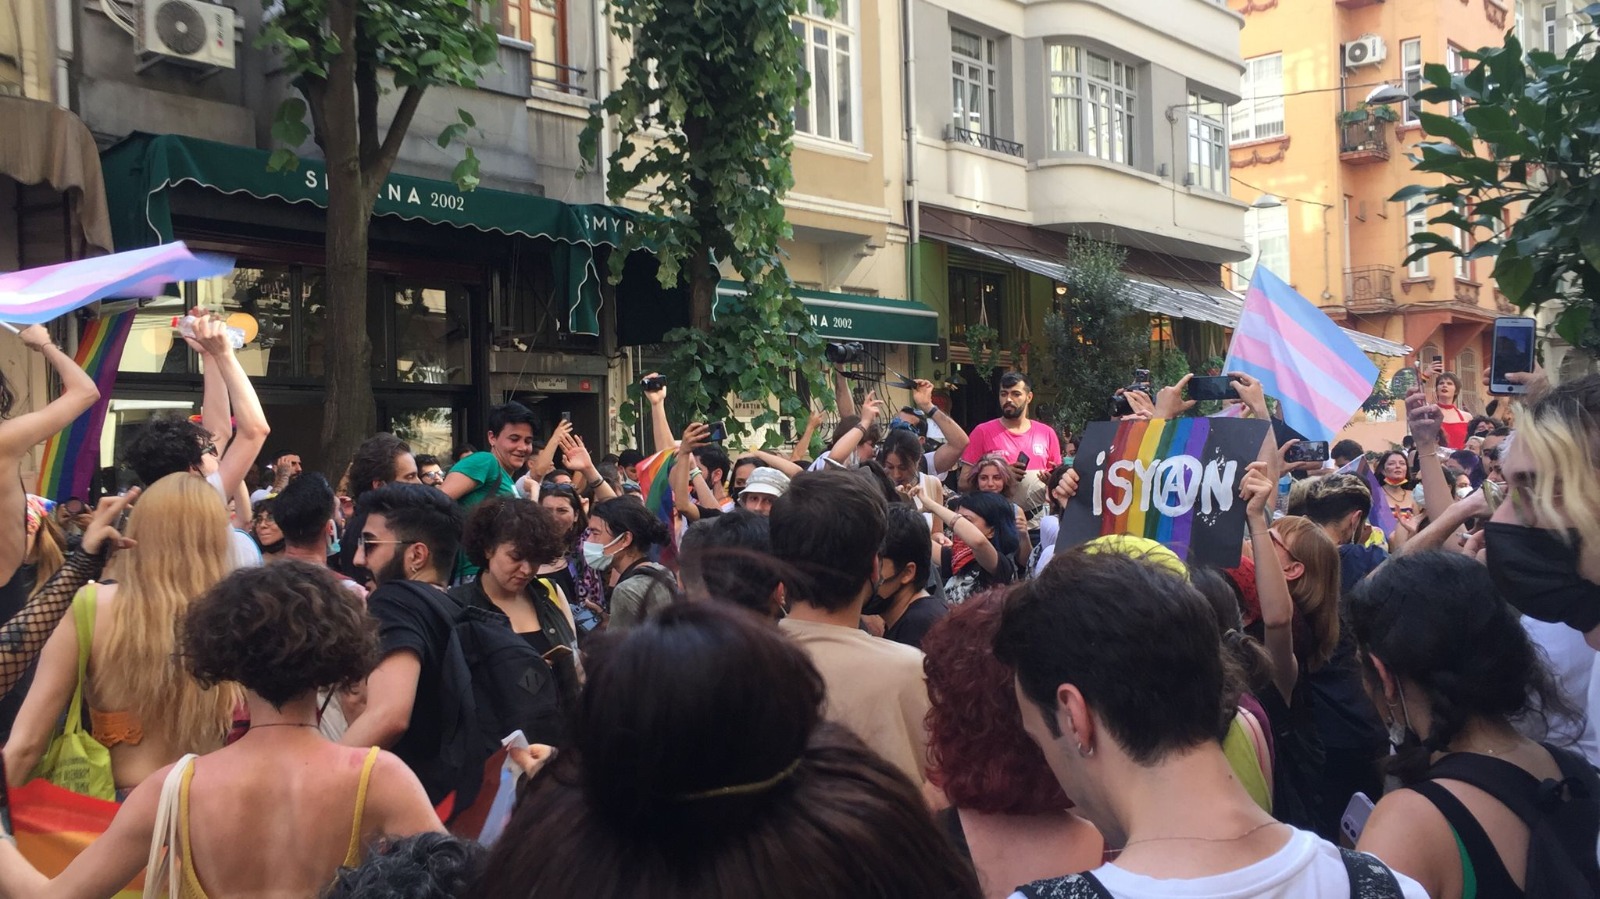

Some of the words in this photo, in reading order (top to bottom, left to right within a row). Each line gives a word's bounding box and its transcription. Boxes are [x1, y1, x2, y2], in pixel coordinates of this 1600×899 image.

[305, 170, 421, 205] SNA
[430, 192, 465, 211] 2002
[832, 316, 853, 329] 2002
